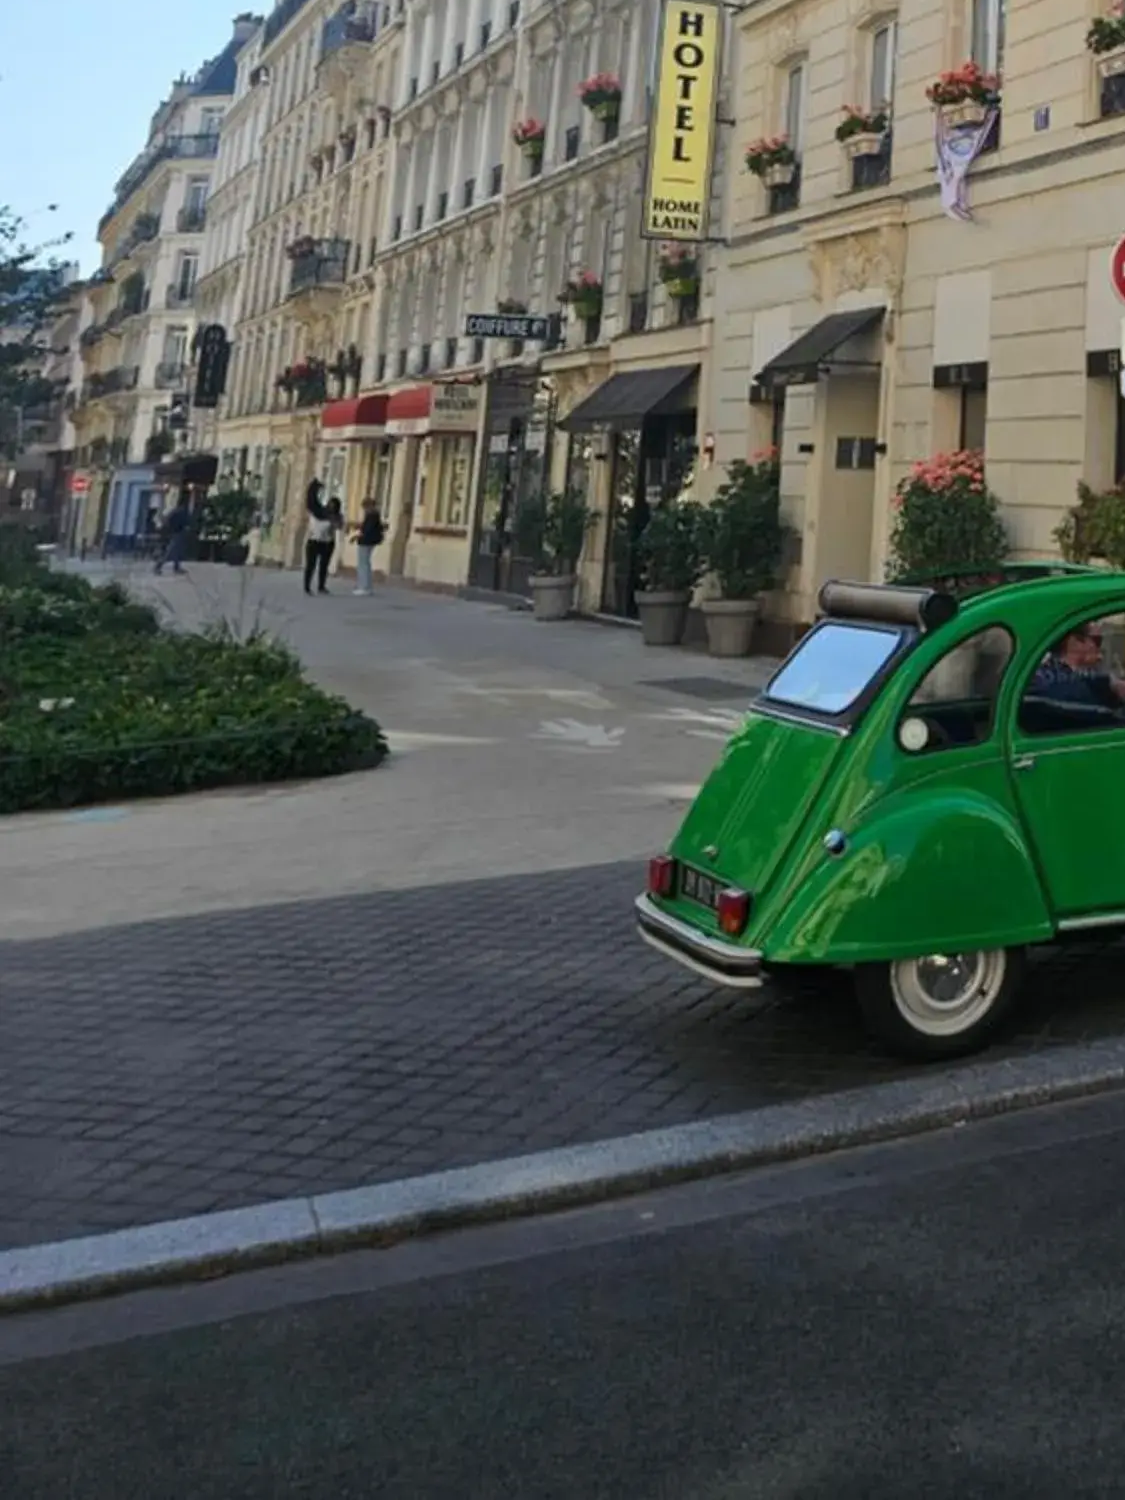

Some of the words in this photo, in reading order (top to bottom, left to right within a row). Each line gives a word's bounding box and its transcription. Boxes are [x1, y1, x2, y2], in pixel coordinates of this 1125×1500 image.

[672, 11, 705, 162] HOTEL
[653, 199, 700, 215] HOME
[652, 214, 699, 231] LATIN
